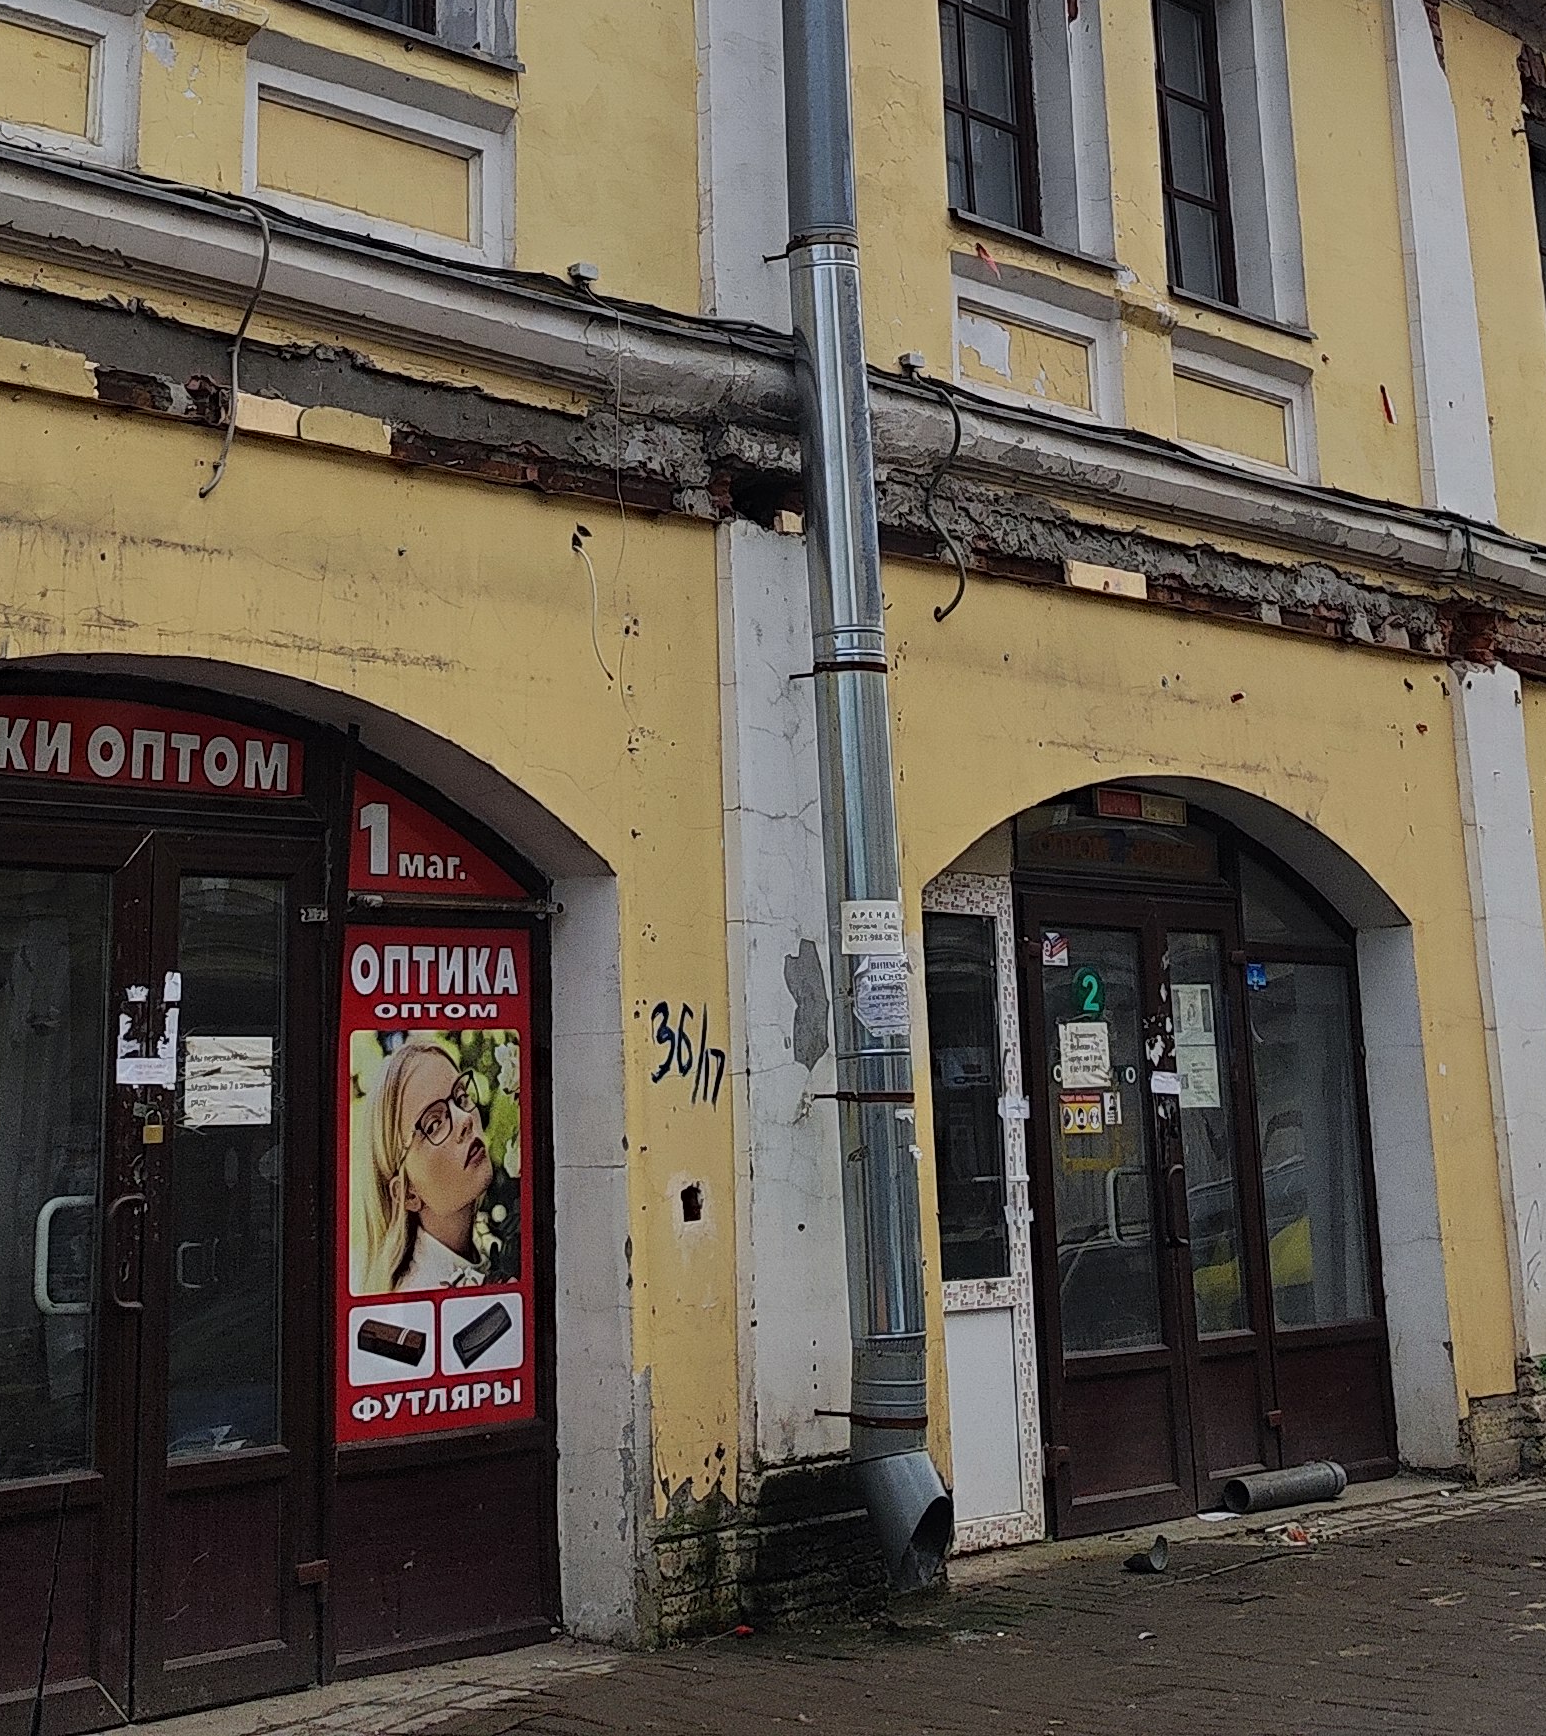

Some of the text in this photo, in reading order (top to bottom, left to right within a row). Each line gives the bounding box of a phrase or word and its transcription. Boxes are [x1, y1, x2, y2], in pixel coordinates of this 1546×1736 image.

[87, 725, 289, 792] ОПТОМ
[359, 802, 467, 881] 1 маг.
[351, 944, 519, 995] ОПТИКА
[1082, 975, 1100, 1011] 2
[374, 1003, 498, 1018] ОПТОМ
[352, 1379, 521, 1422] ФУТЛЯРЫ
